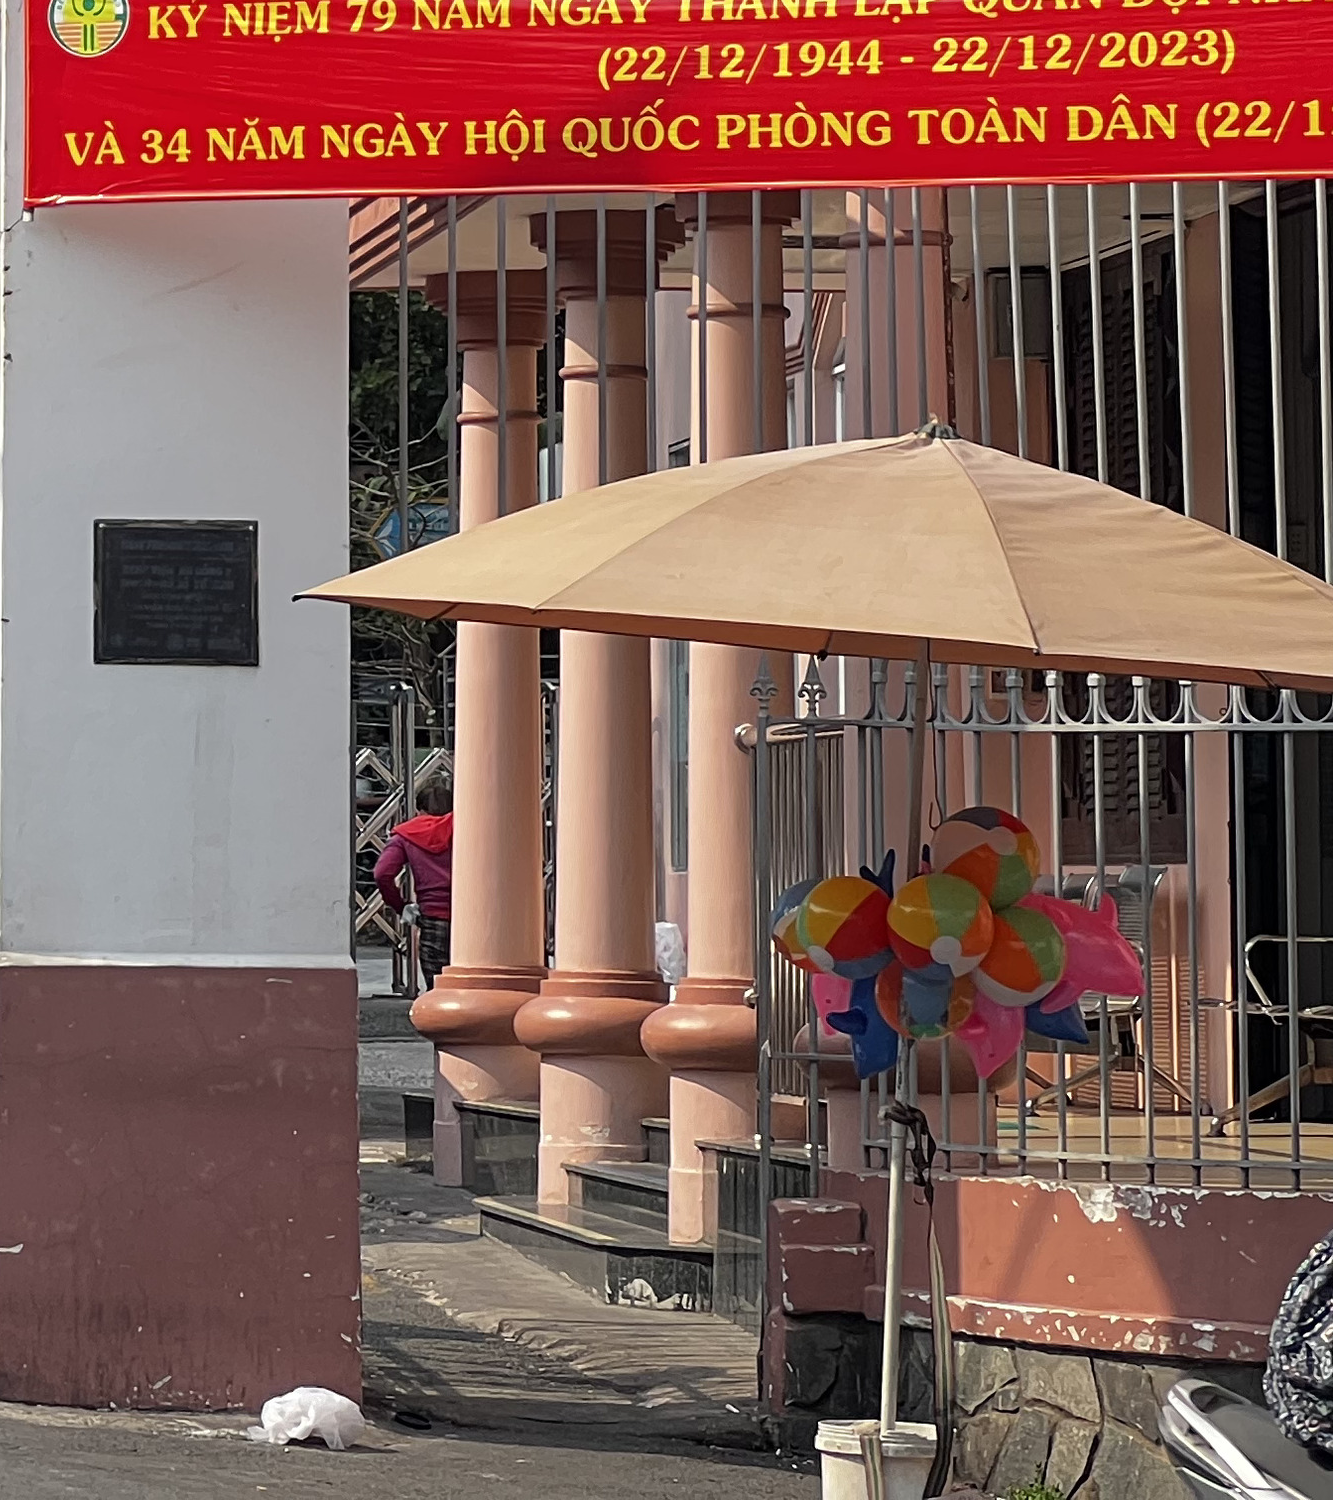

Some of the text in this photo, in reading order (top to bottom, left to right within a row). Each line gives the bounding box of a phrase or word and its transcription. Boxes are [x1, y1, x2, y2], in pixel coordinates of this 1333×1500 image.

[598, 29, 1236, 91] (22/12/1944 - 22/12/2023)
[65, 92, 1333, 167] VÀ 34 NĂM NGÀY HỘI QUỐC PHÒNG TOÀN DÂN (22/1
